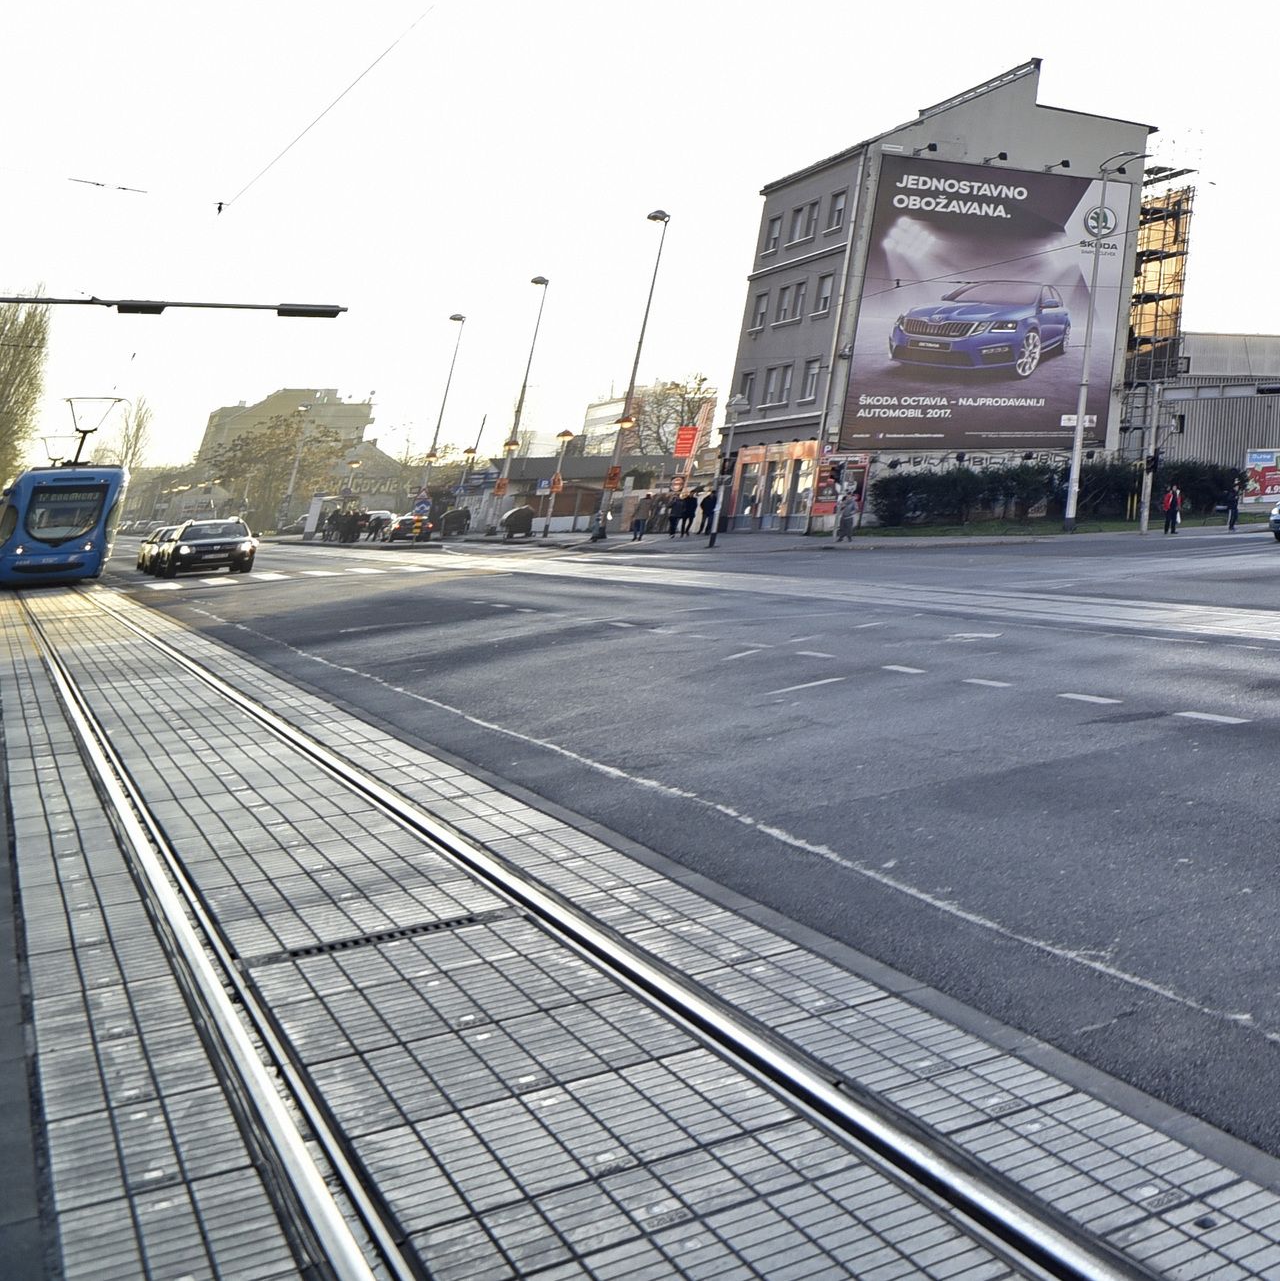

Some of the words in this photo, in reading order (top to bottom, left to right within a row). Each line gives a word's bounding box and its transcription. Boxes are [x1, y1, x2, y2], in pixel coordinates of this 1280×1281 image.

[895, 174, 1028, 200] JEDNOSTAVNO
[892, 194, 1012, 218] OBOŽAVANA.
[858, 394, 899, 406] ŠKODA
[901, 396, 948, 406] OCTAVIA
[958, 397, 1045, 407] NAJPRODAVANIJI
[856, 408, 924, 418] AUTOMOBIL
[926, 408, 952, 418] 2017.
[823, 445, 832, 453] P
